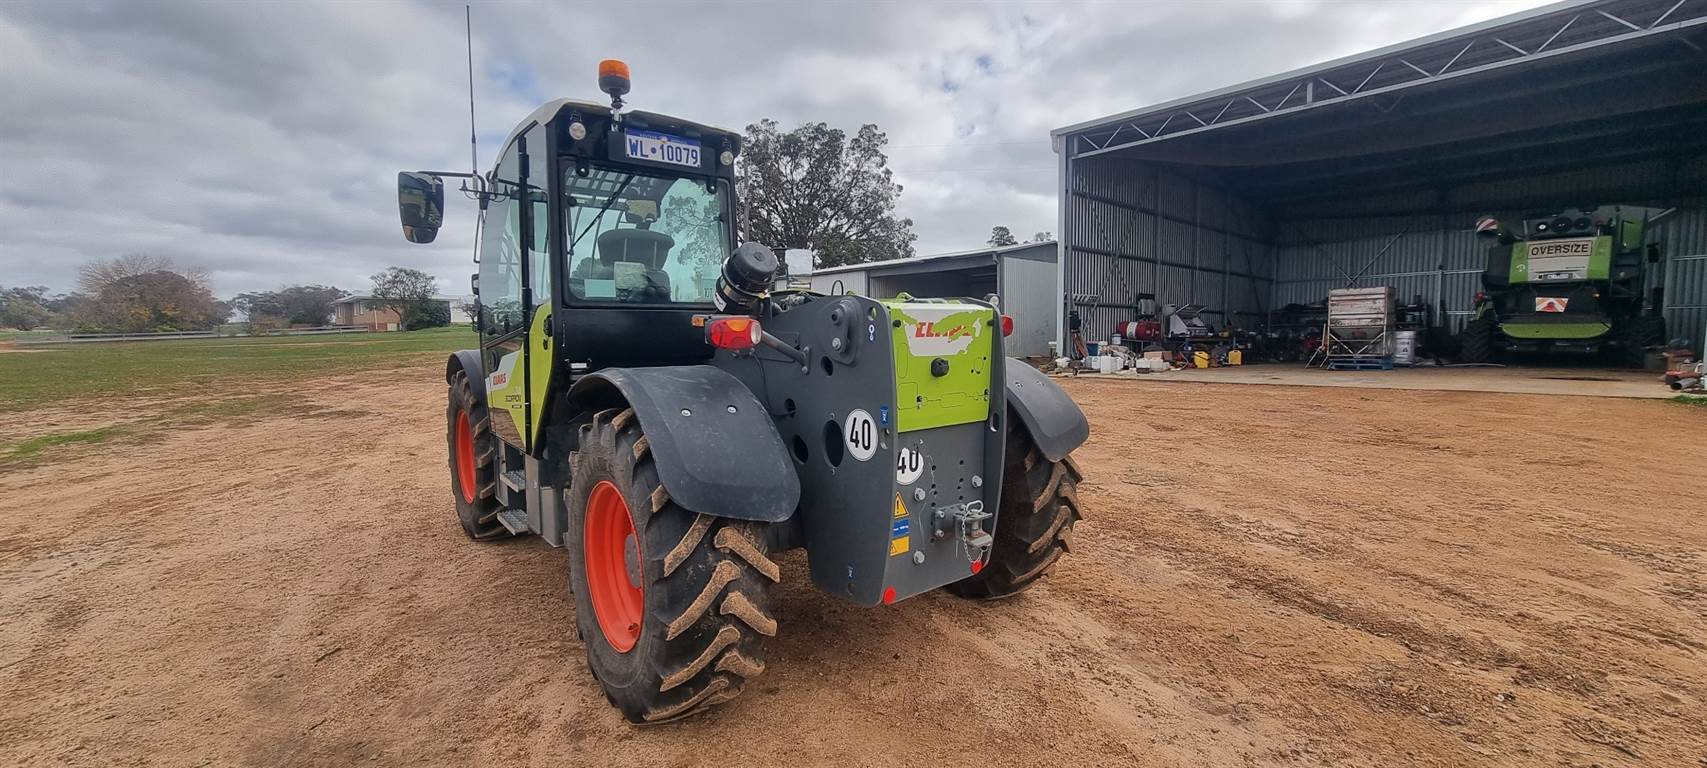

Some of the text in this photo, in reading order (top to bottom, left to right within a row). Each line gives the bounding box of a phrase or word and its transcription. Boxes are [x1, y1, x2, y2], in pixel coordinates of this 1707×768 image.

[629, 138, 698, 165] WL 10079
[1531, 243, 1589, 256] OVERSIZE
[850, 417, 871, 450] 40
[897, 446, 919, 474] 40
